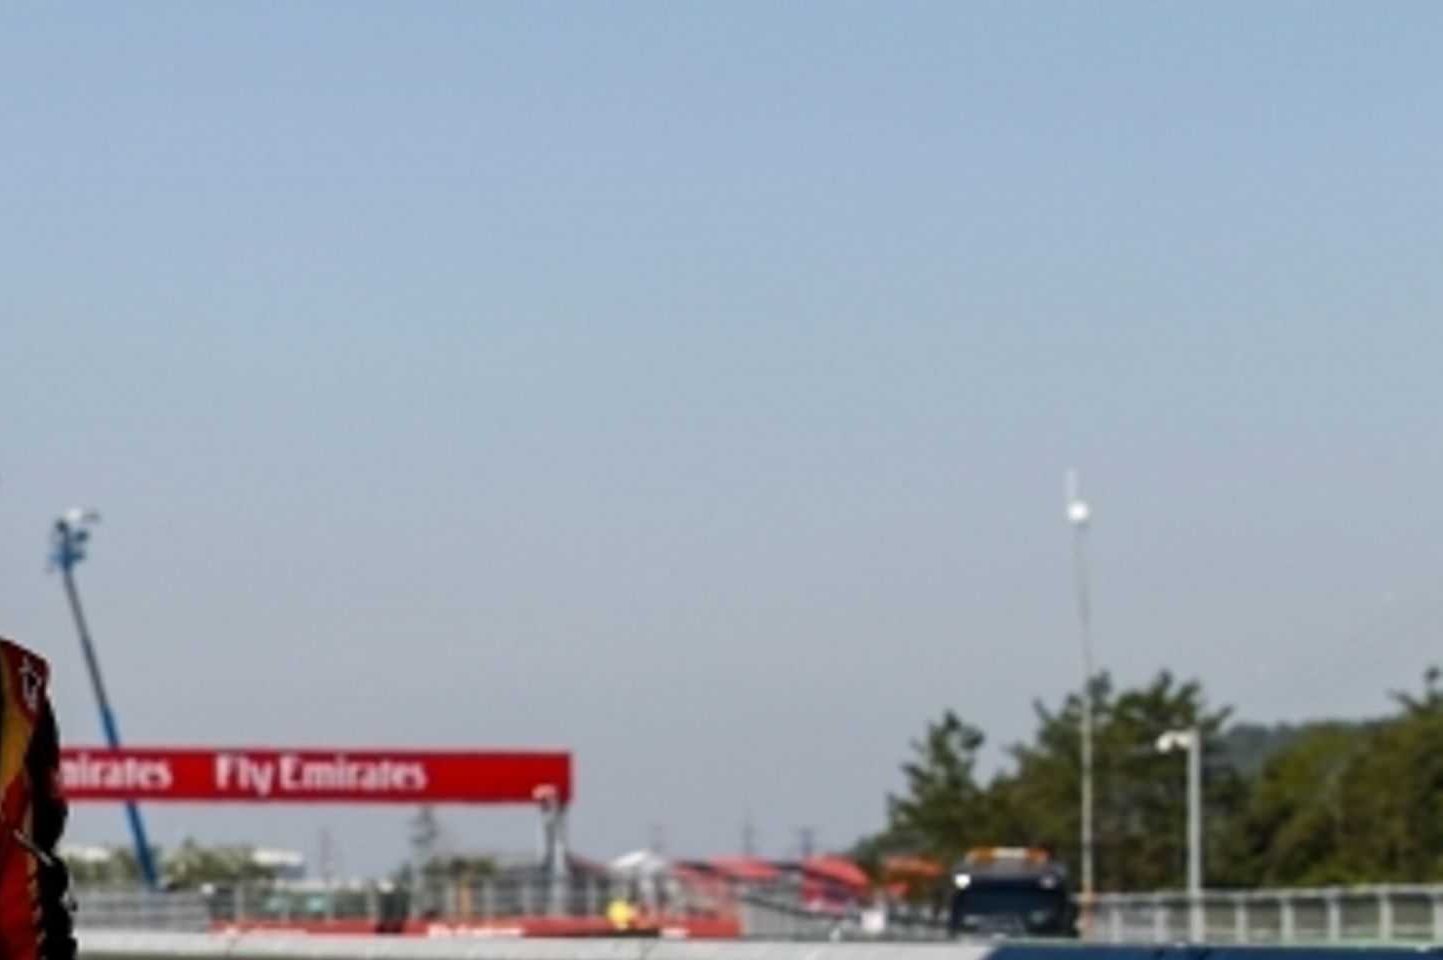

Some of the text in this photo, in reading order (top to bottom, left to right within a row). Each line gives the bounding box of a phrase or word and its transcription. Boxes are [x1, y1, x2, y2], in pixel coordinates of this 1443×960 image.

[59, 754, 172, 790] mirates
[215, 754, 428, 797] Fly Emirates
